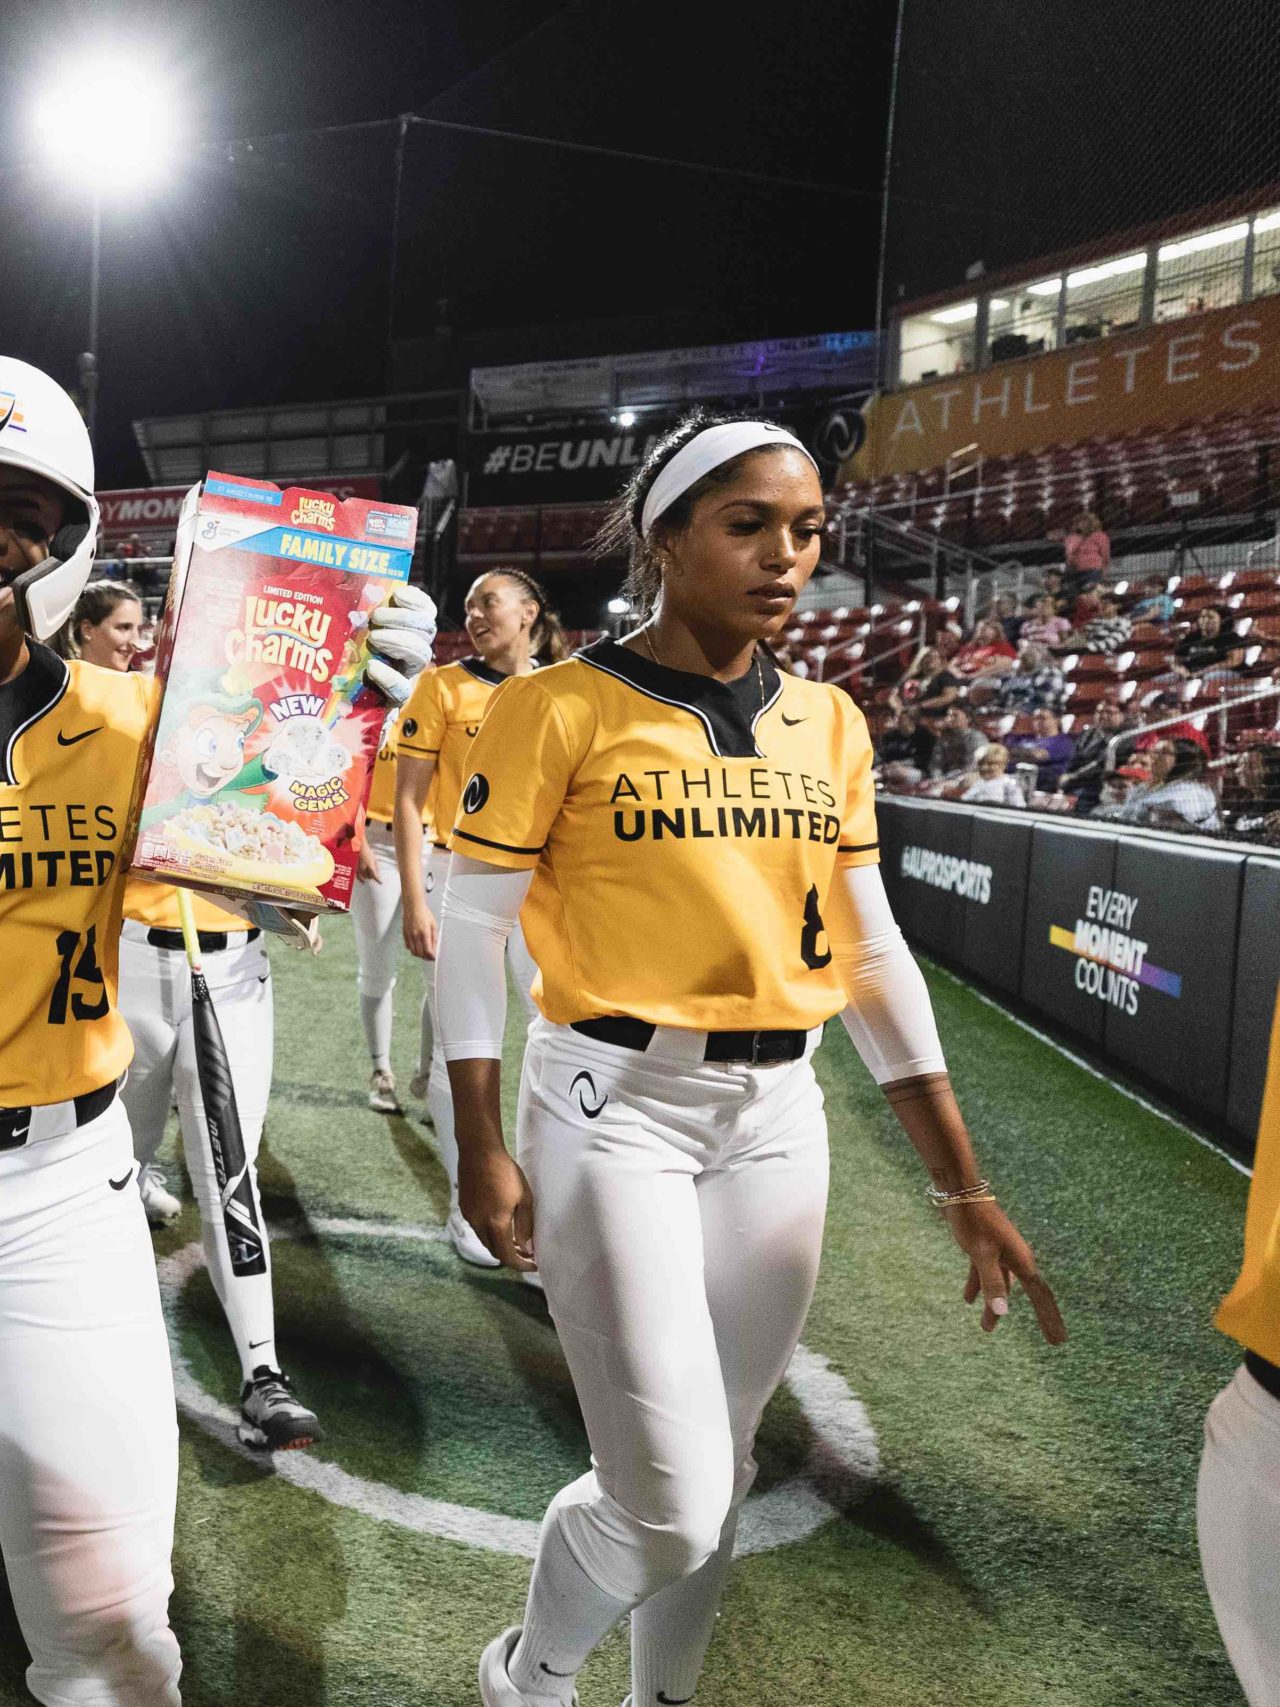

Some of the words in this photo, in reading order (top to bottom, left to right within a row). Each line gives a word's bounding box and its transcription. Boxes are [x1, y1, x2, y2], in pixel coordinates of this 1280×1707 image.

[890, 318, 1261, 441] ATHLETES
[290, 510, 336, 532] Charms
[280, 534, 349, 566] FAMILY
[348, 547, 391, 574] SIZE
[263, 585, 293, 599] LIMITED
[293, 591, 324, 605] EDITION
[224, 628, 333, 683] Charms
[268, 694, 326, 723] NEW
[288, 776, 343, 799] MAGIC
[293, 788, 351, 812] GEMS!
[610, 768, 836, 808] ATHLETES
[614, 807, 841, 845] UNLIMITED
[1086, 885, 1139, 931] EVERY
[1072, 919, 1148, 976] MOMENT
[47, 923, 110, 1025] 15
[1074, 959, 1140, 1016] COUNTS
